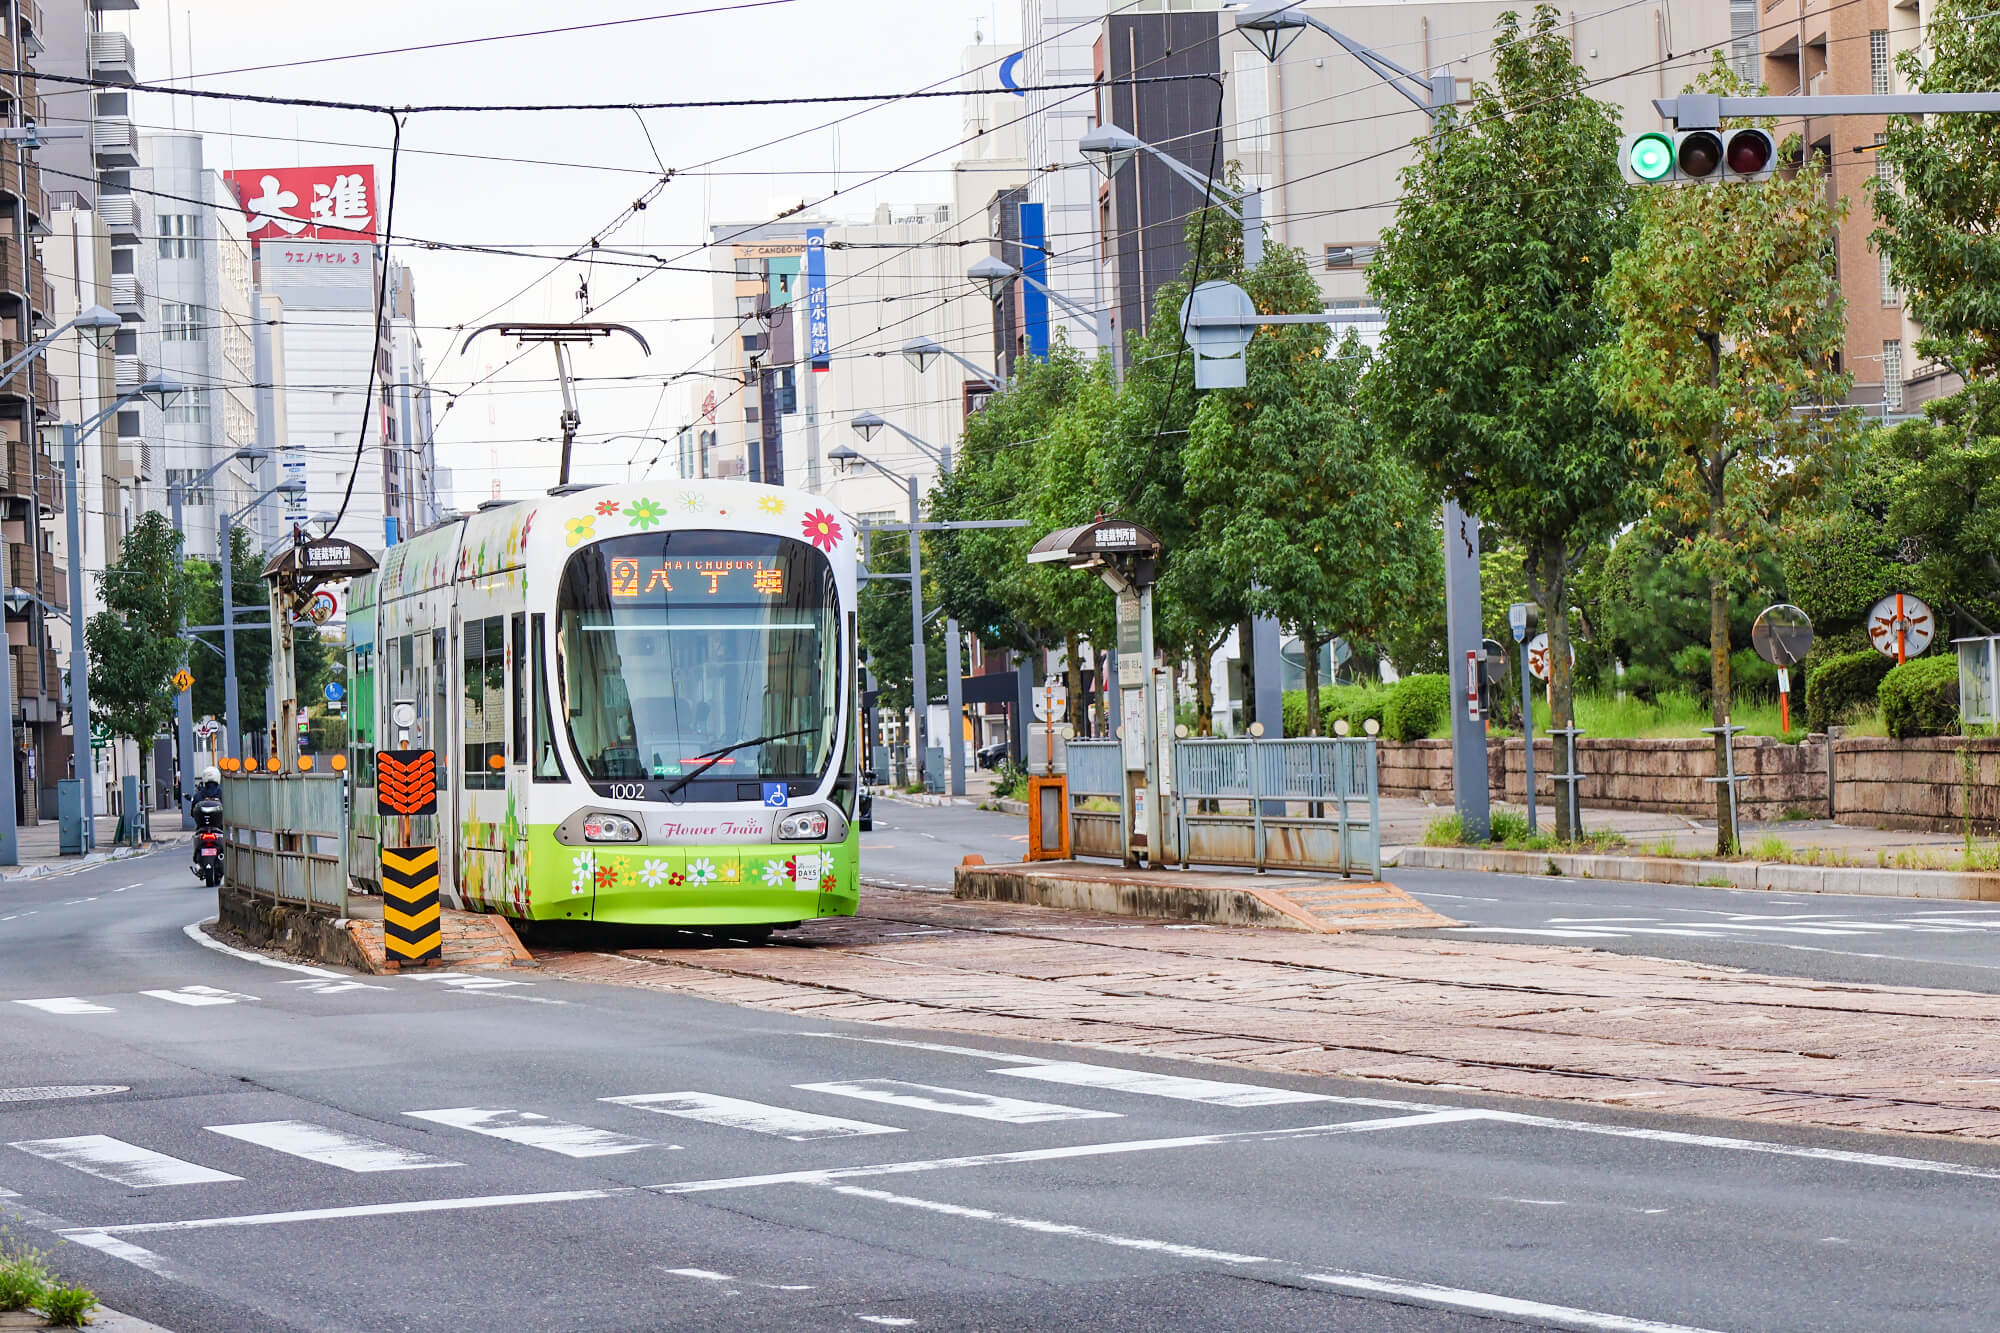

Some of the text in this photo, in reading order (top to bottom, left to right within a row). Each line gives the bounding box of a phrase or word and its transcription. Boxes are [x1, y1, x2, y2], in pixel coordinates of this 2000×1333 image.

[247, 173, 373, 235] 大進
[284, 250, 360, 265] ウエノヤビル 3
[758, 246, 793, 255] CANDEO
[810, 286, 828, 356] 清水建設
[615, 562, 636, 592] 9
[644, 569, 783, 595] 八丁堀
[609, 783, 645, 800] 1002
[660, 819, 763, 838] Flower Train
[797, 869, 818, 877] DAYS
